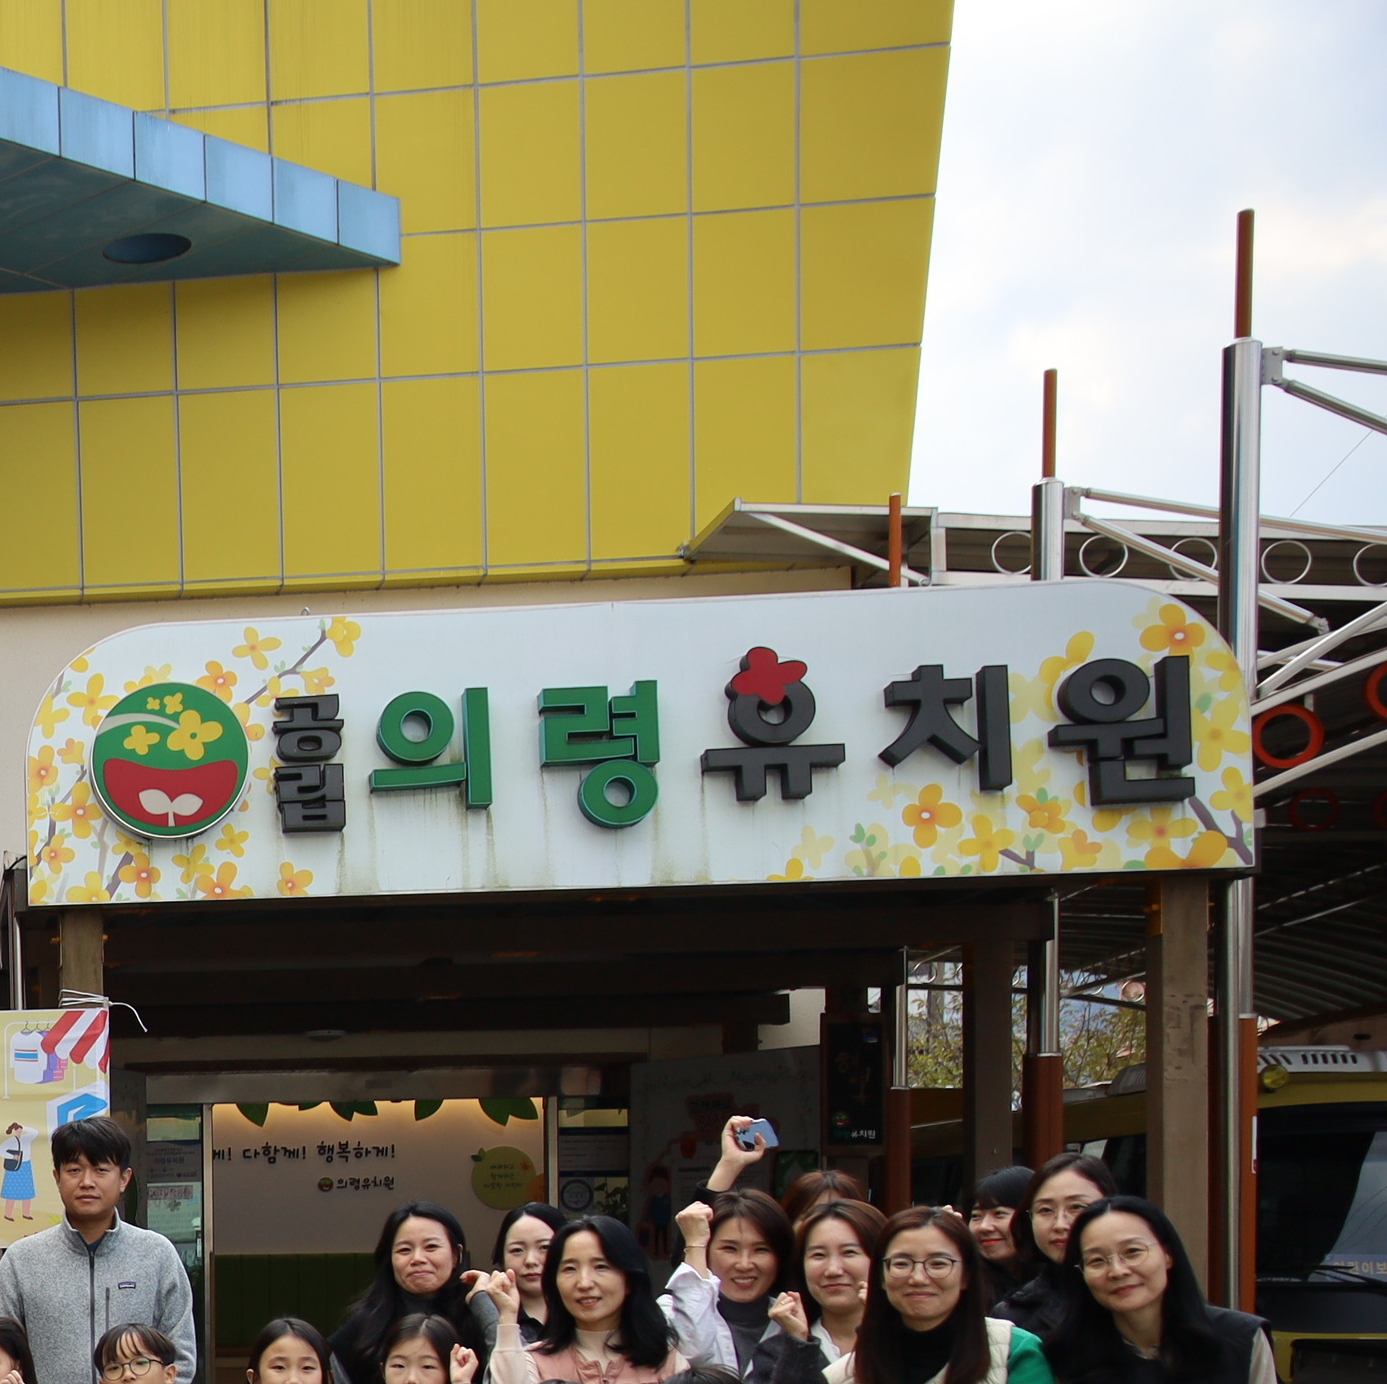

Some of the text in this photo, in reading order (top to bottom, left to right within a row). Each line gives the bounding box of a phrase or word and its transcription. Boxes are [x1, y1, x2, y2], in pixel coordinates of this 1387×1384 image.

[272, 693, 346, 834] 공립
[242, 1141, 306, 1165] 다함께!
[316, 1140, 395, 1164] 행복하게!
[336, 1175, 395, 1191] 의령유치원
